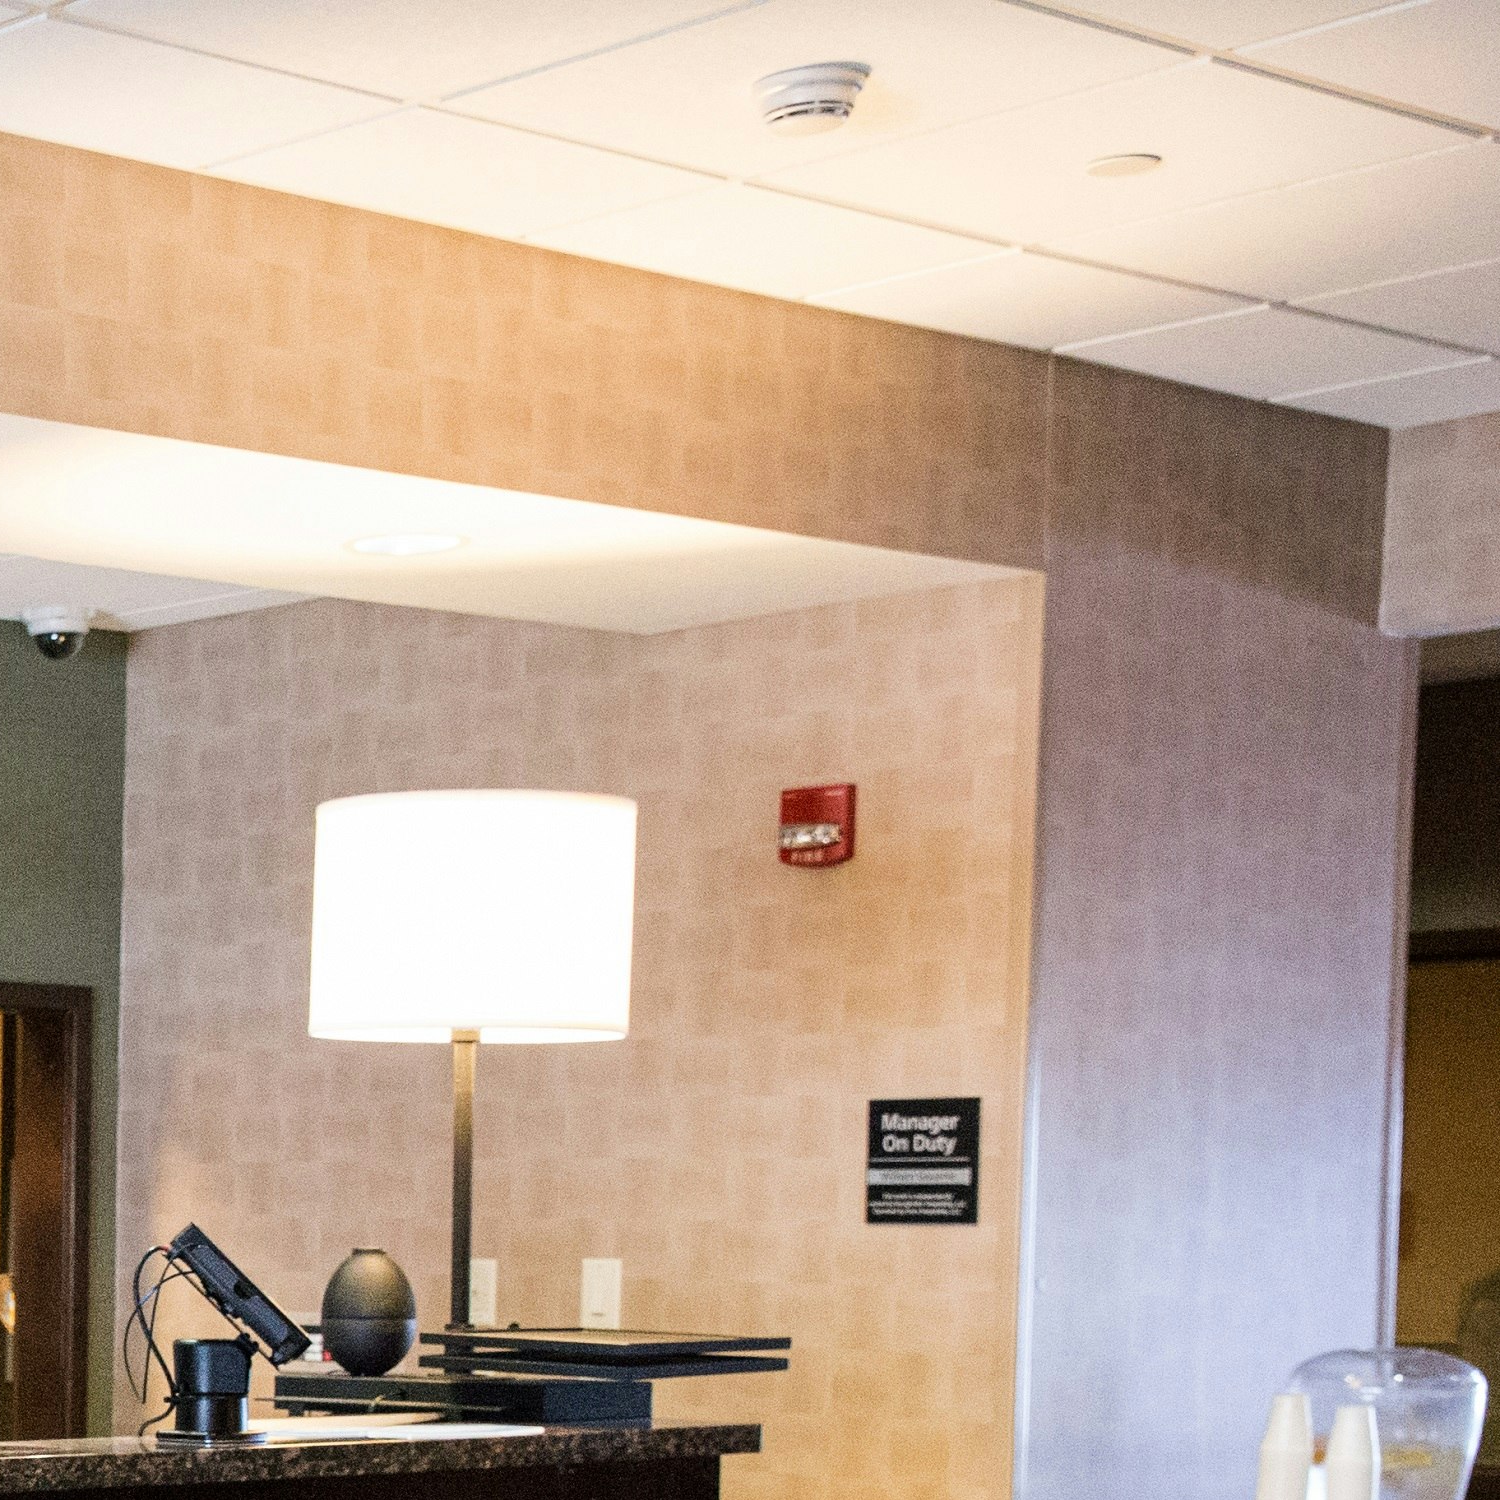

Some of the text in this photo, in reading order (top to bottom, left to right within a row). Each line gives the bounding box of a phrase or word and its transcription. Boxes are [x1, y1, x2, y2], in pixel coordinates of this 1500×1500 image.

[881, 1113, 960, 1135] Manager
[882, 1134, 957, 1156] On Duty
